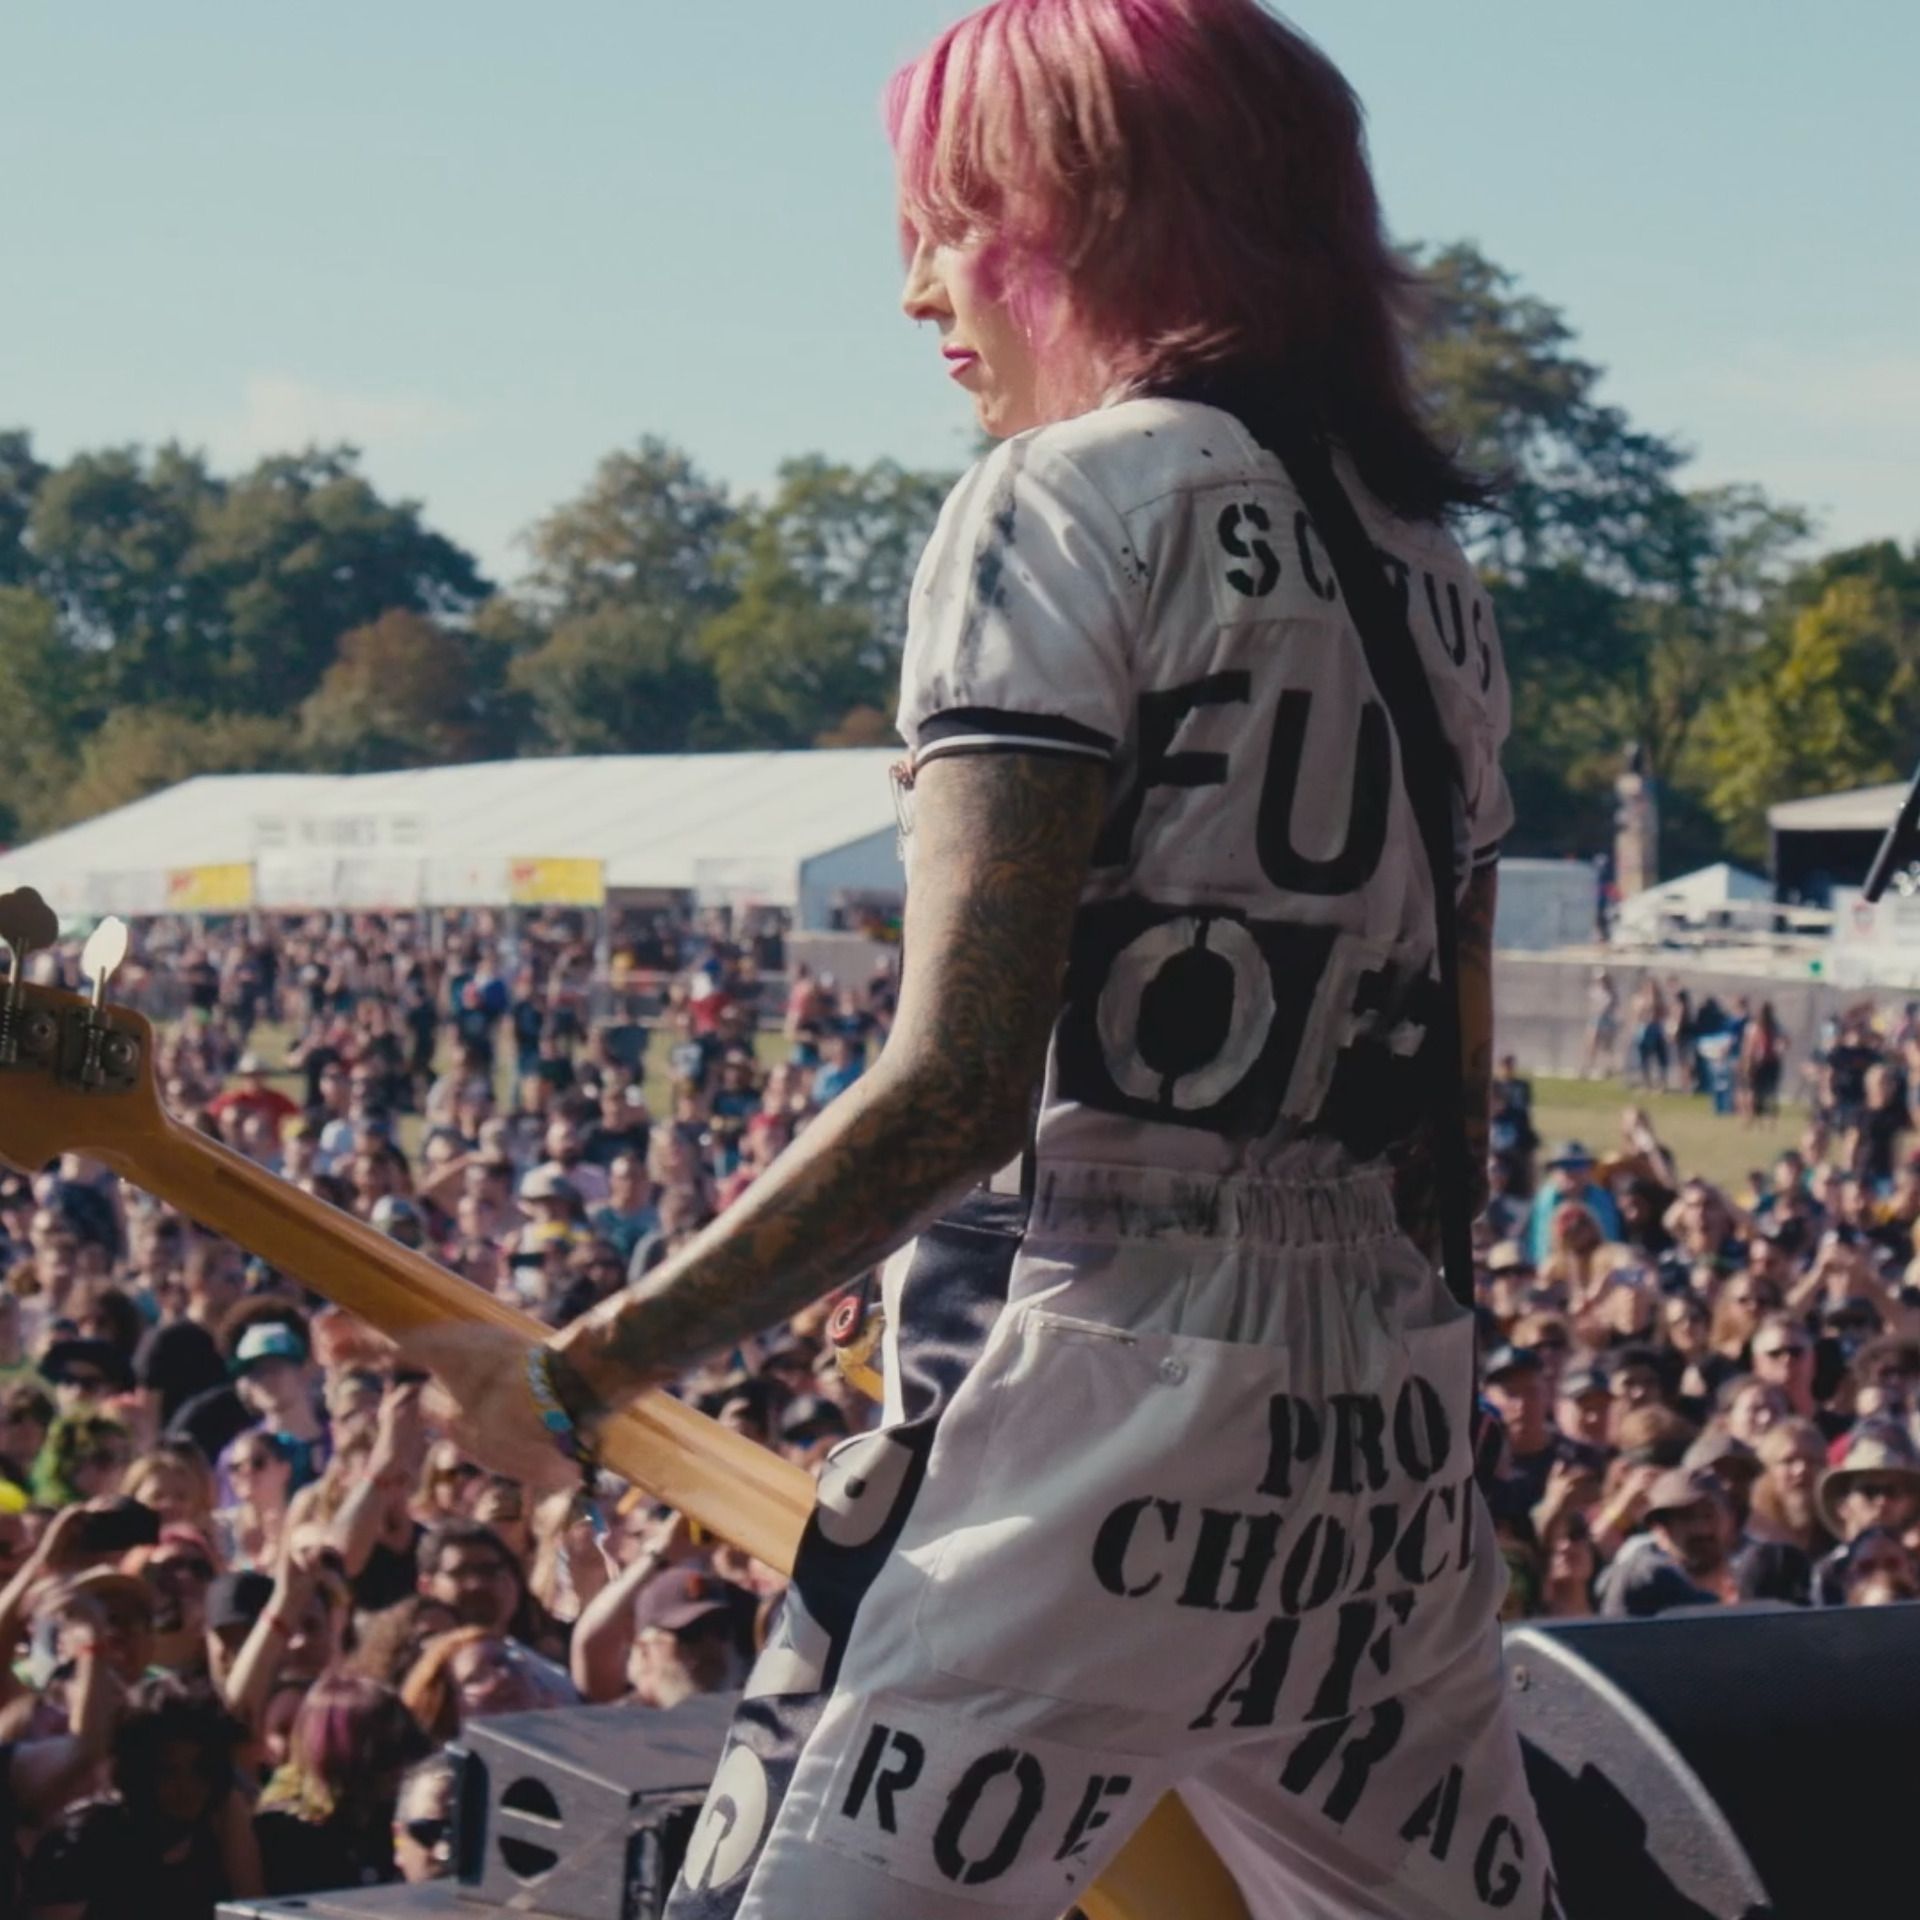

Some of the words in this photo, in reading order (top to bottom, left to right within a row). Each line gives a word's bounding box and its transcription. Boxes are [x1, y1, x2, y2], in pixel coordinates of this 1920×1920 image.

[1256, 1375, 1451, 1498] PRO
[841, 1722, 1133, 1887] ROE
[1278, 1696, 1545, 1907] RAG
